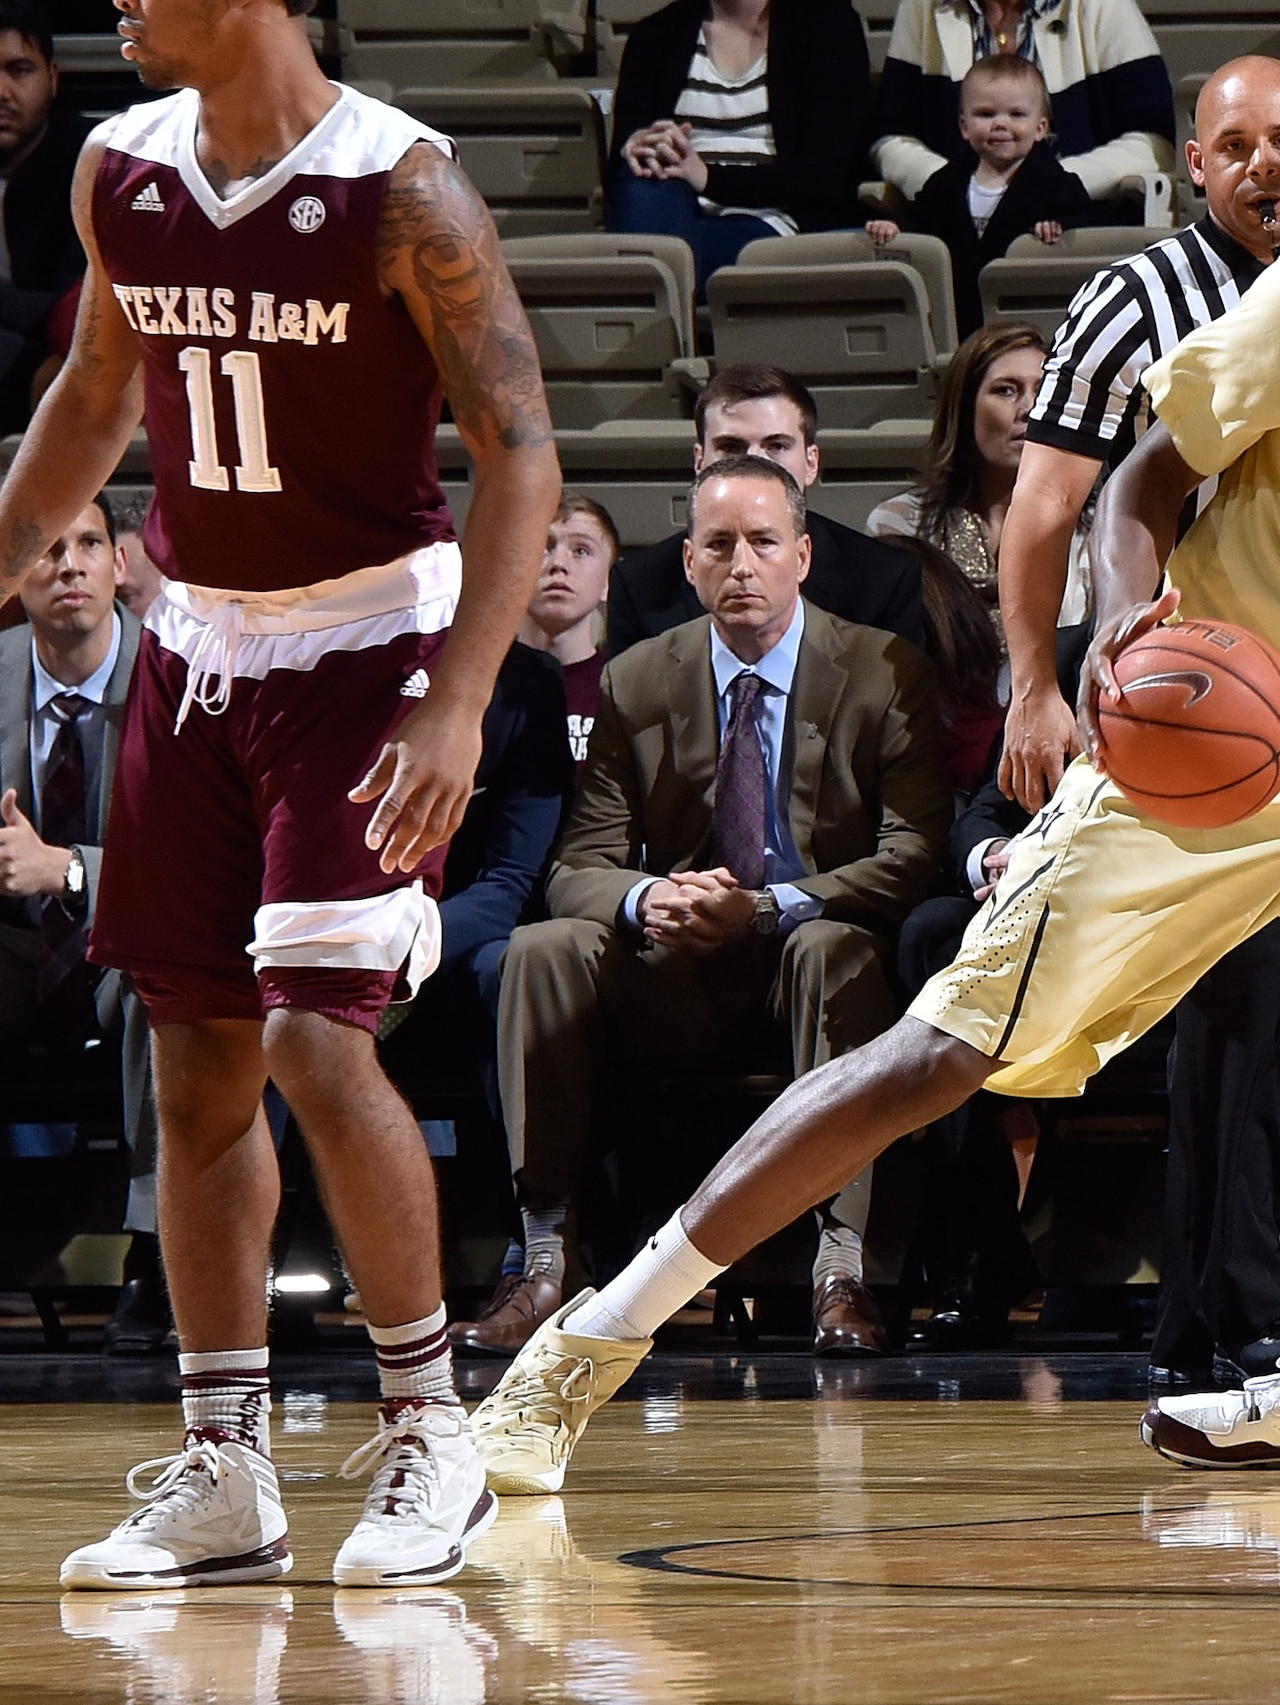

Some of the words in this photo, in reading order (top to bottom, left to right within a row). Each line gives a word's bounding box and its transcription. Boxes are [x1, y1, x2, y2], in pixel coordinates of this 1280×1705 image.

[131, 200, 165, 212] adidas
[291, 197, 323, 230] SEC
[112, 283, 236, 338] TEXAS
[248, 291, 350, 346] A&M
[178, 346, 283, 492] 11
